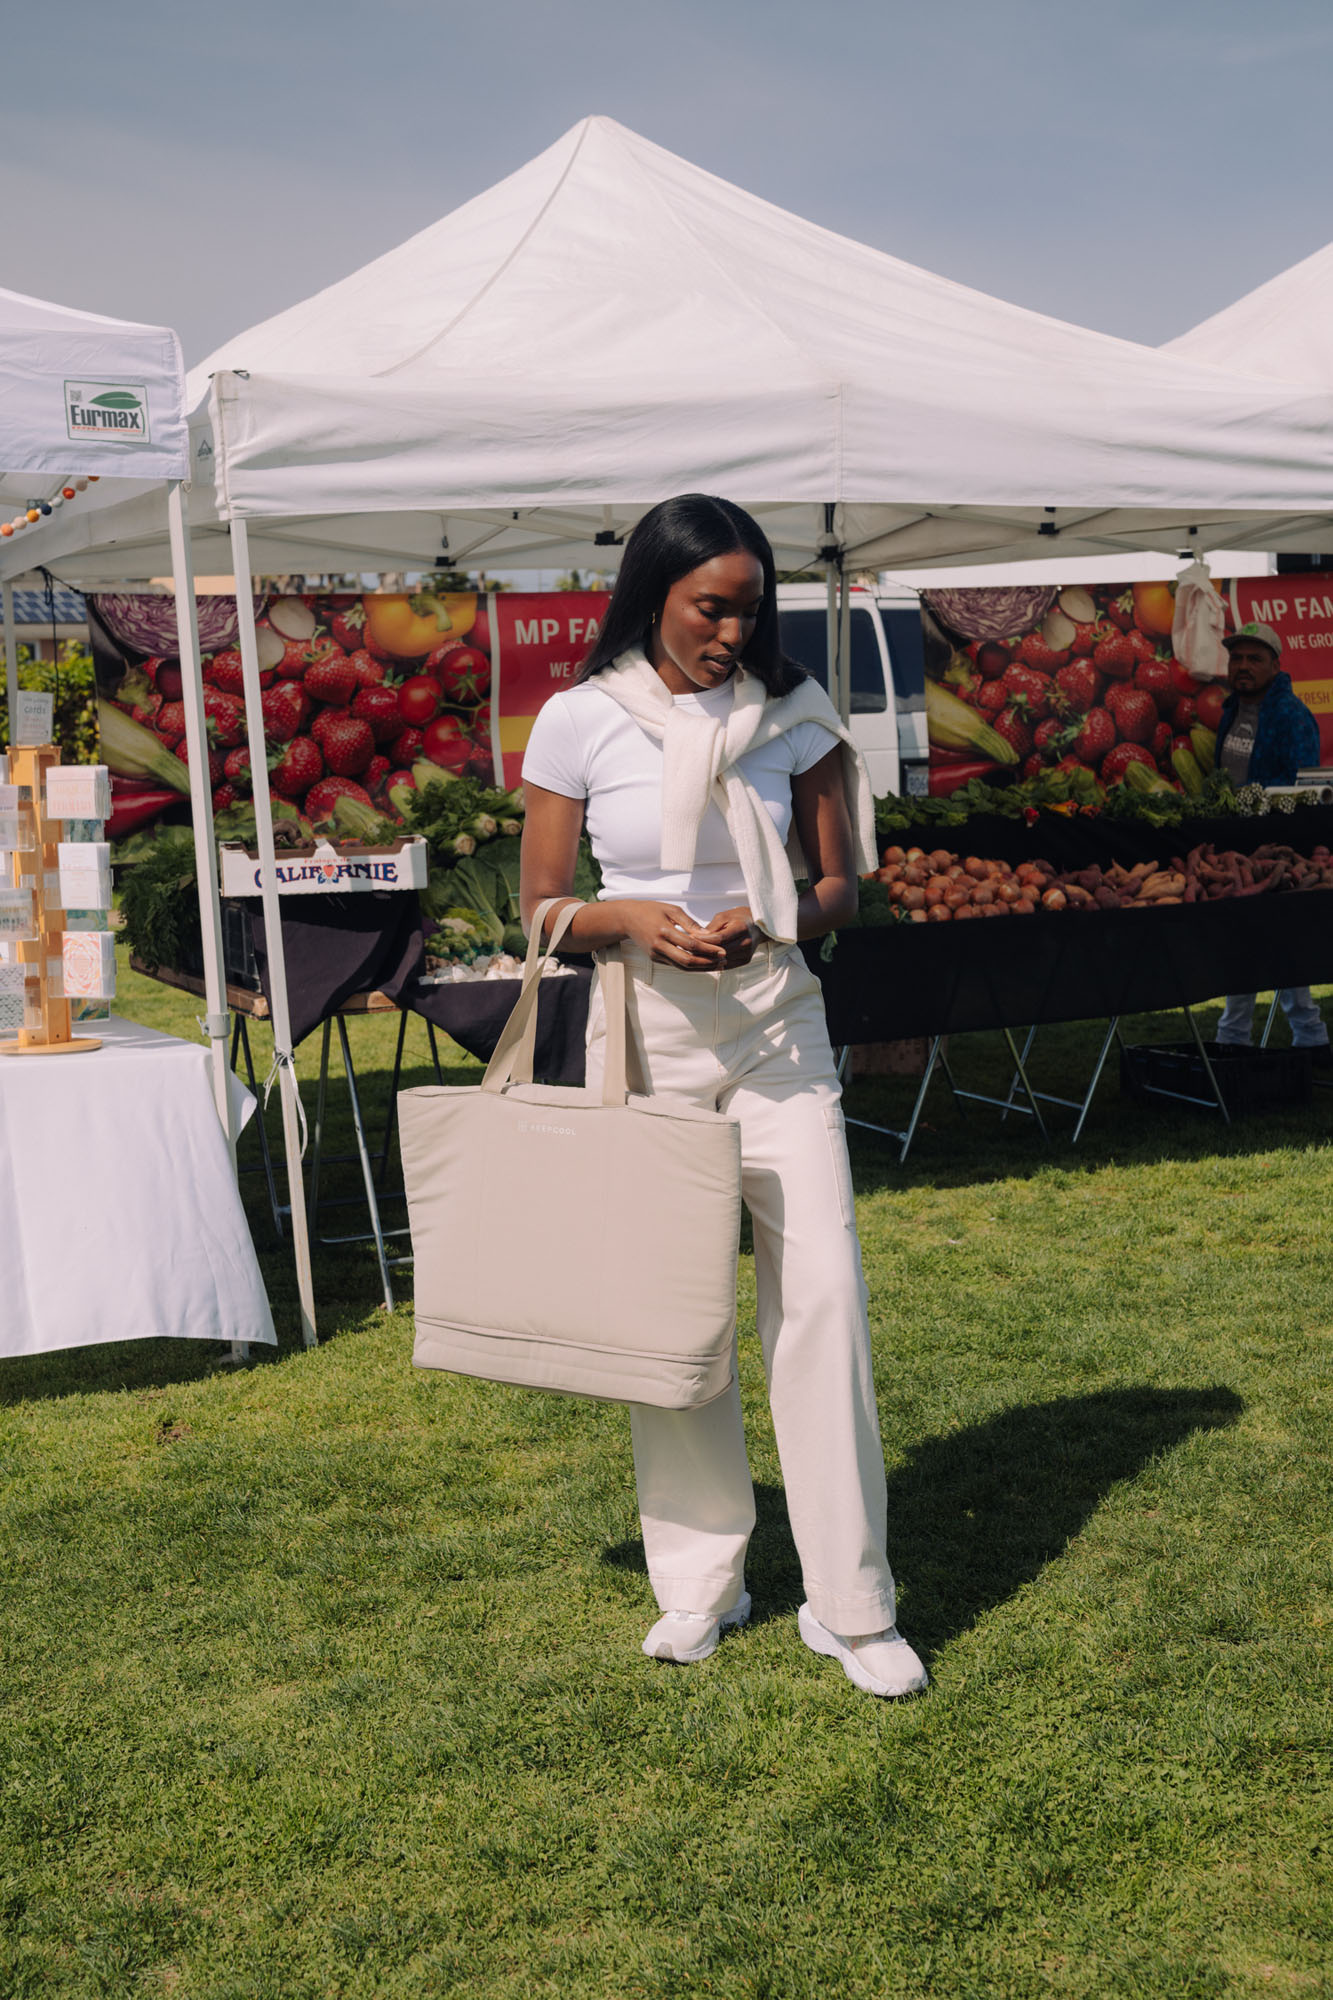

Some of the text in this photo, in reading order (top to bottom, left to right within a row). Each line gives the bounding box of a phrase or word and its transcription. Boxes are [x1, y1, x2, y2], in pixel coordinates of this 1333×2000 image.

[71, 405, 140, 429] Eurmax
[1251, 598, 1288, 621] MP
[515, 617, 603, 644] MP FA
[1286, 632, 1333, 650] WE GRO
[550, 661, 571, 678] WE
